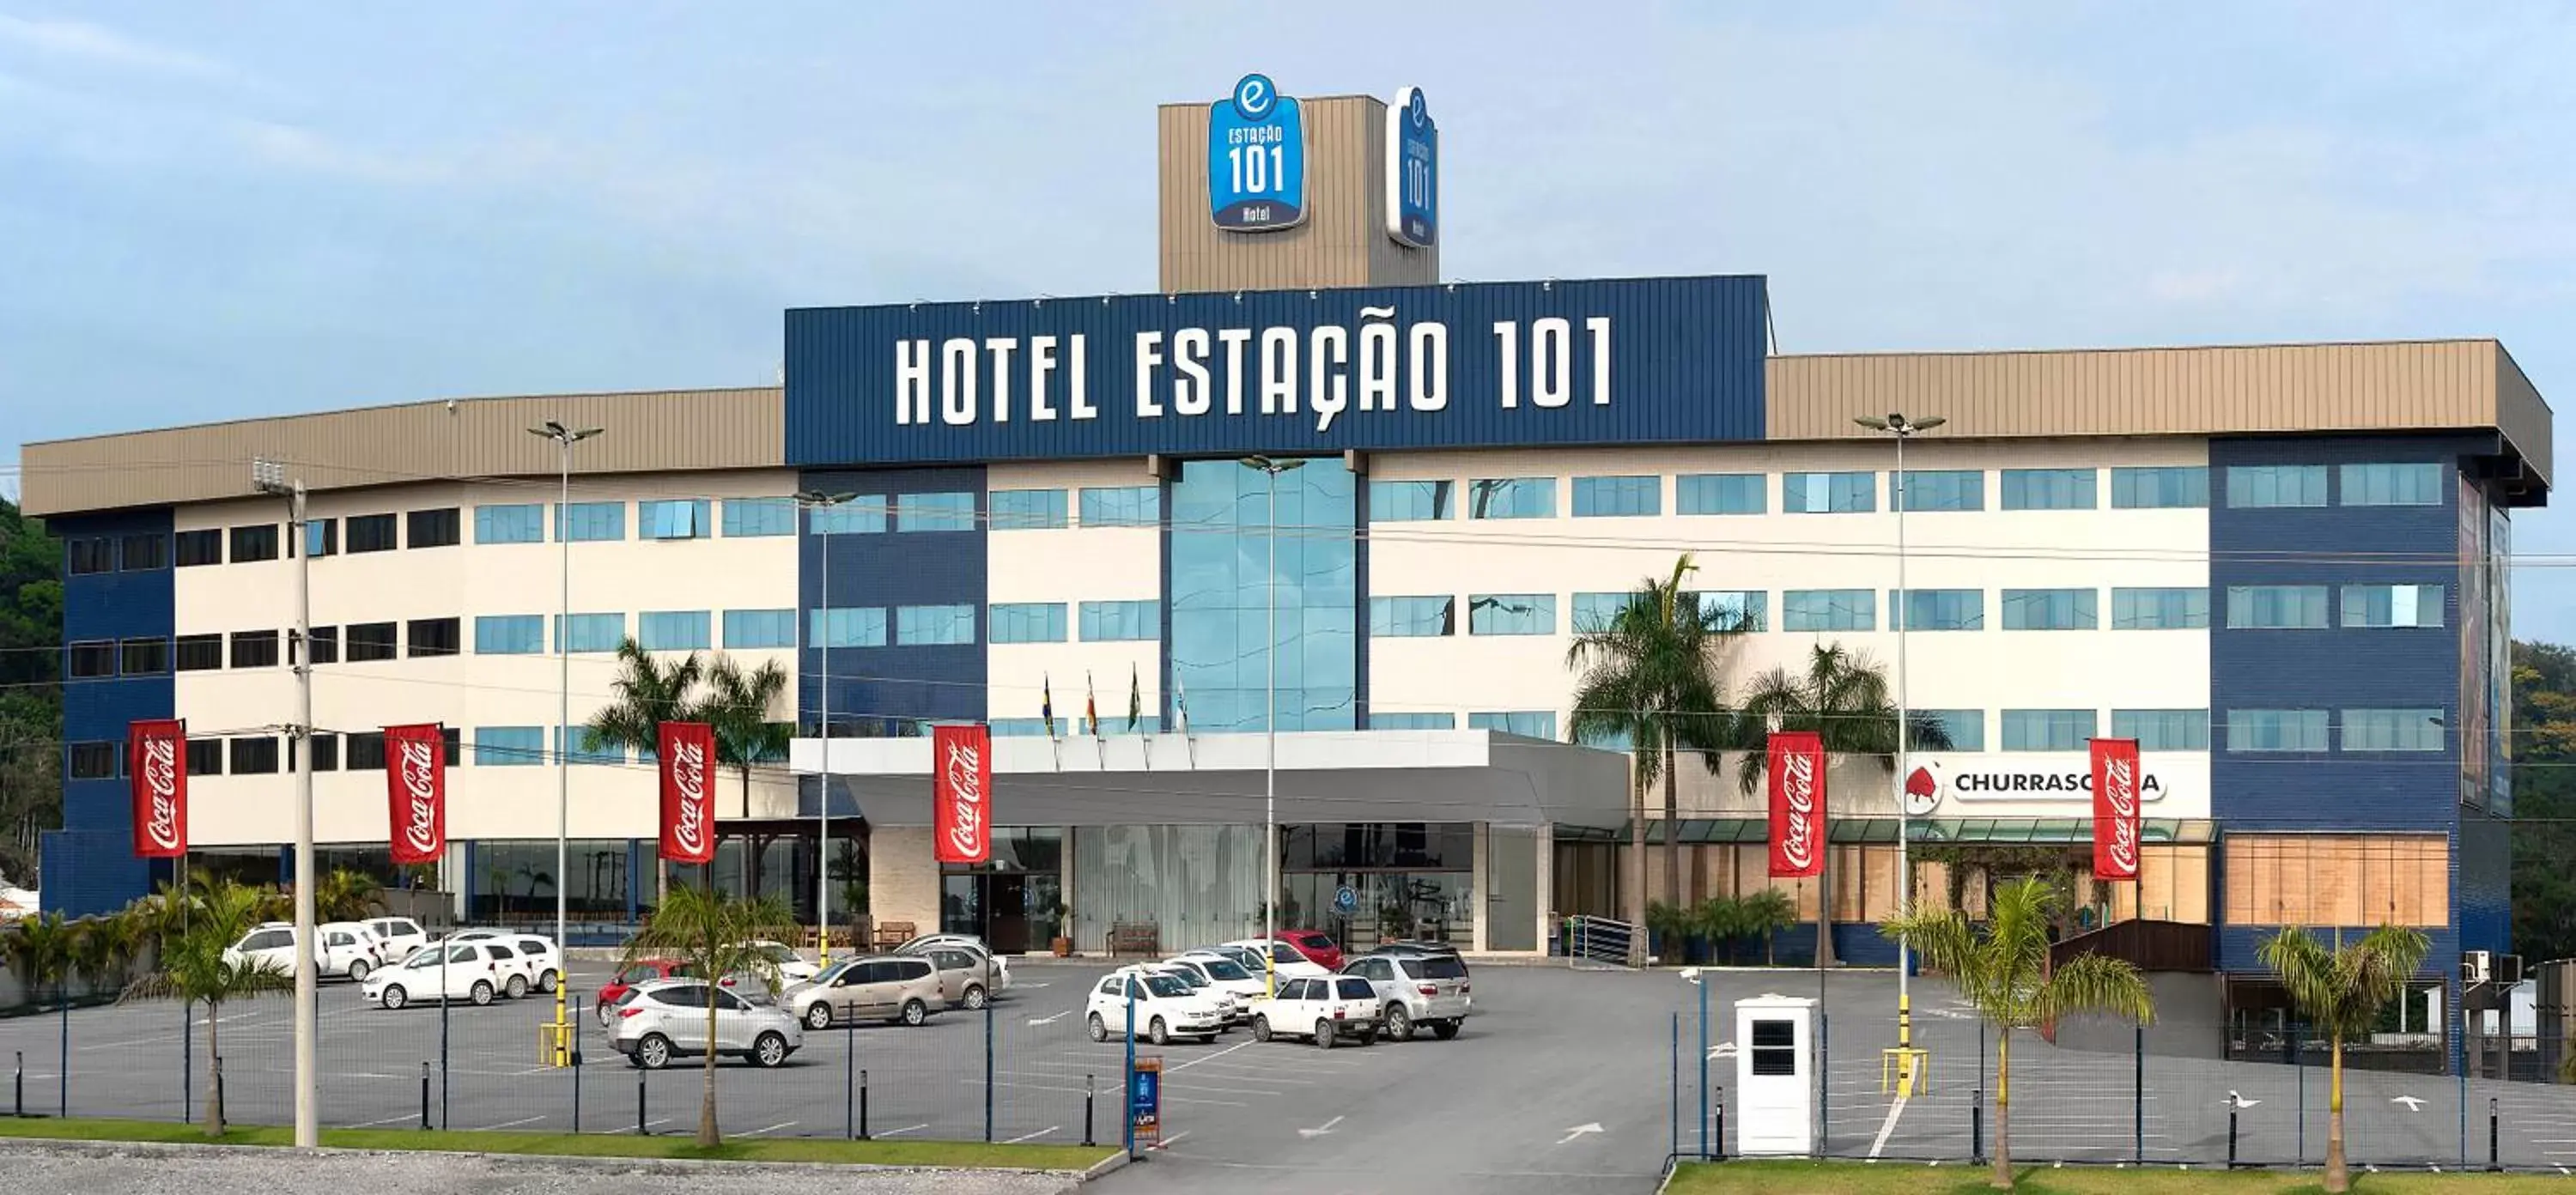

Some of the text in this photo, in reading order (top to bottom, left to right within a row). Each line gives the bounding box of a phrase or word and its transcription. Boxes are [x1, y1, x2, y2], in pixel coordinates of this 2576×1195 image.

[1241, 80, 1269, 112] e
[1229, 125, 1283, 144] ESTAÇÃO
[1229, 144, 1284, 193] 101
[1407, 158, 1430, 211] 101
[1242, 206, 1271, 221] Hotel
[896, 305, 1611, 432] HOTEL ESTAÇÃO 101
[1955, 773, 2160, 792] CHURRASCA
